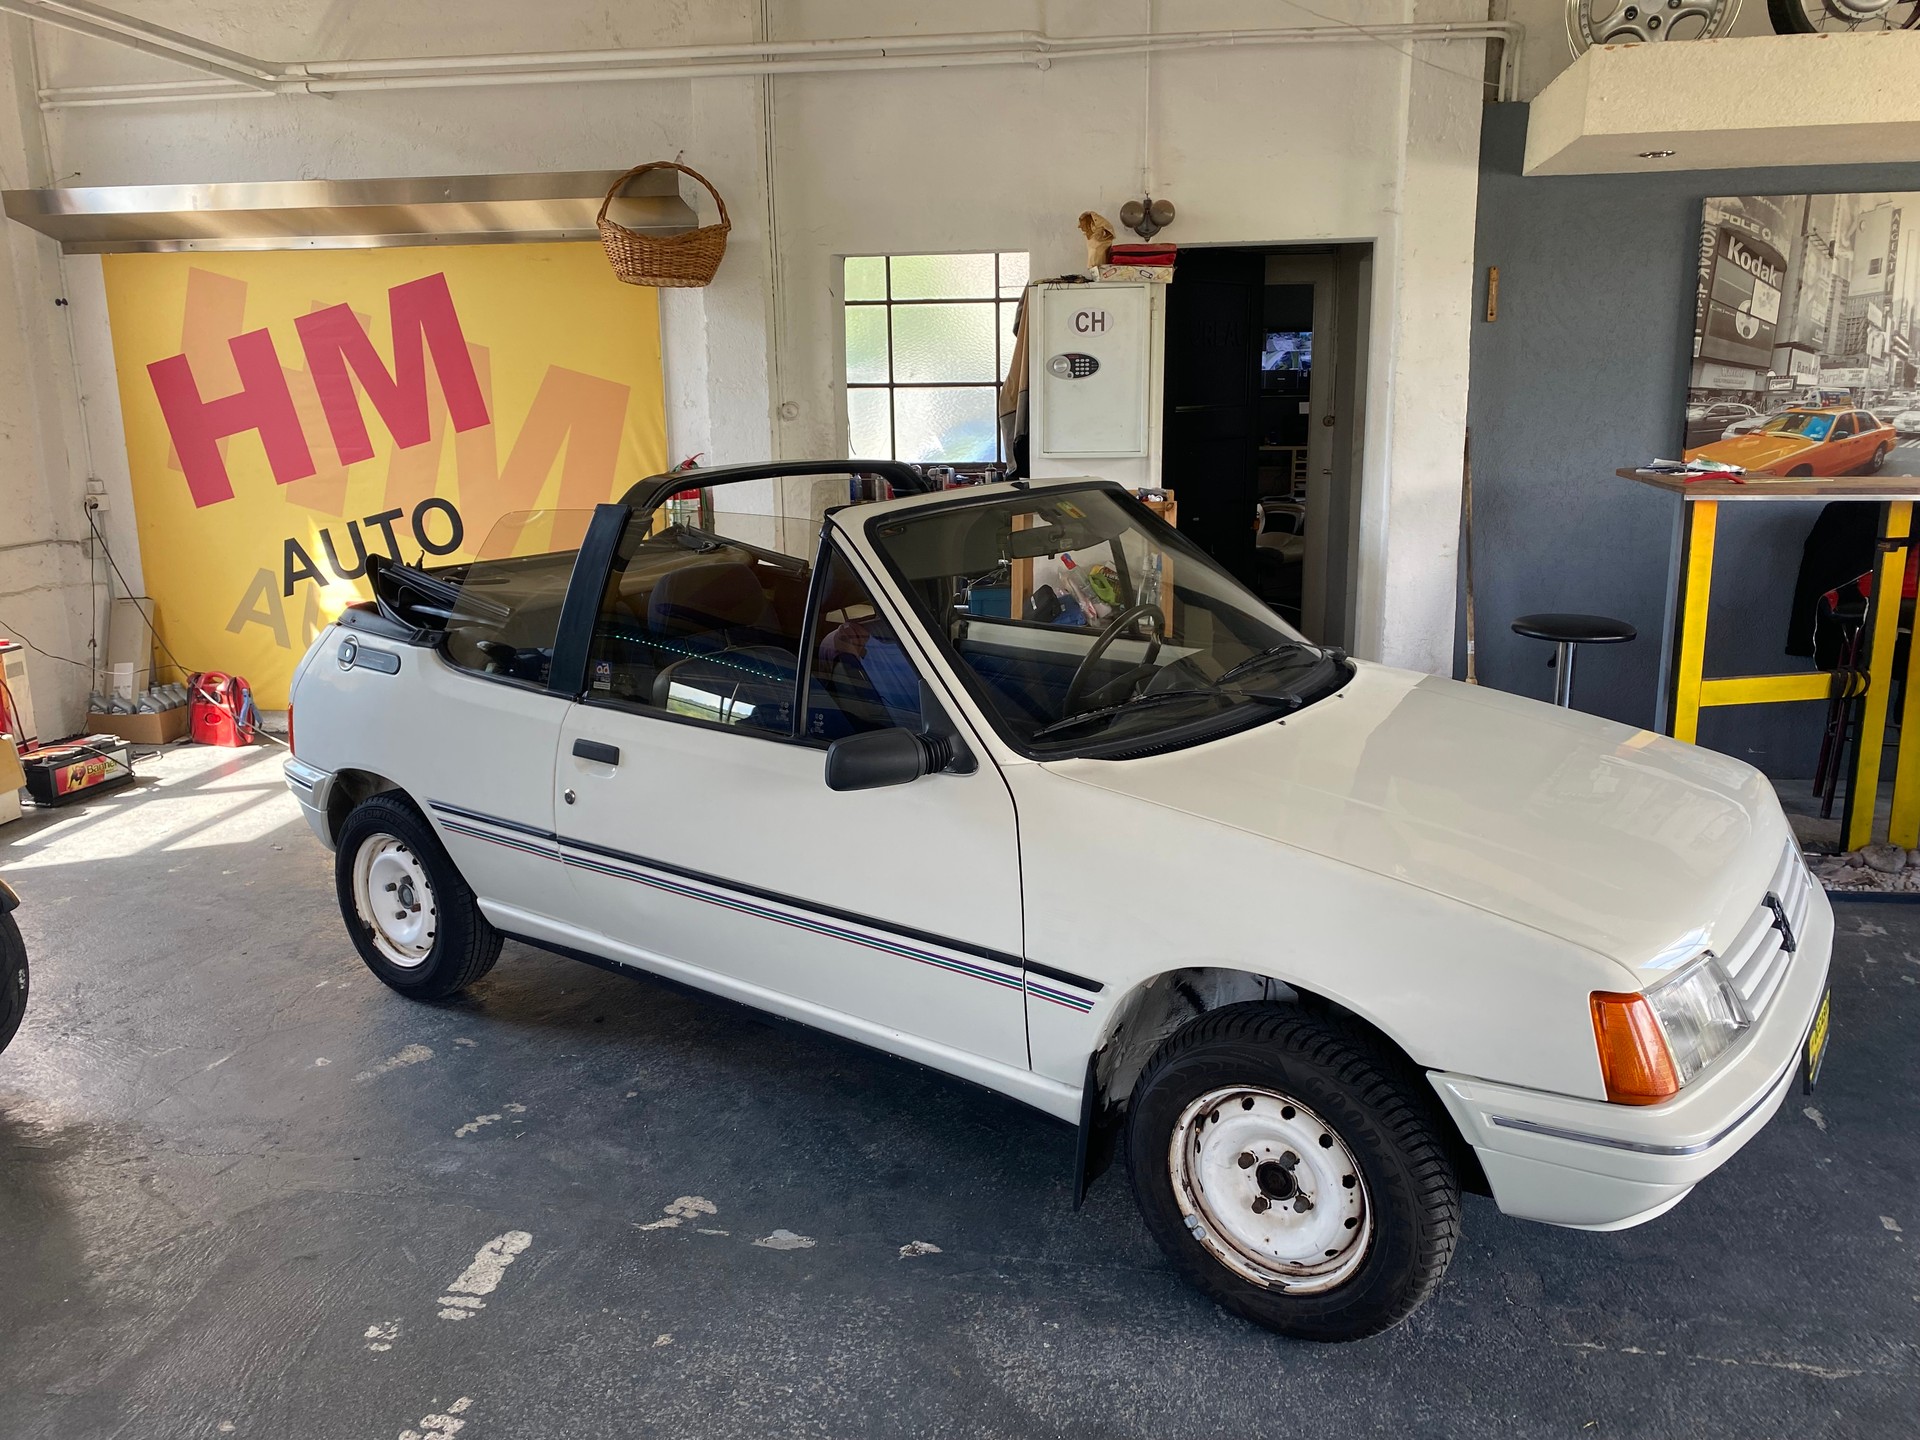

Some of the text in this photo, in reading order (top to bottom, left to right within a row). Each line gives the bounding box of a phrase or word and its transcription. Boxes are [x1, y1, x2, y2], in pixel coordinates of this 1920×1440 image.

[1699, 223, 1717, 280] KODAK
[1728, 236, 1777, 287] Kodak
[1075, 311, 1105, 332] CH
[146, 272, 491, 509] HM
[1797, 361, 1812, 375] Bank
[282, 498, 463, 597] AUTO
[86, 760, 118, 775] Banner
